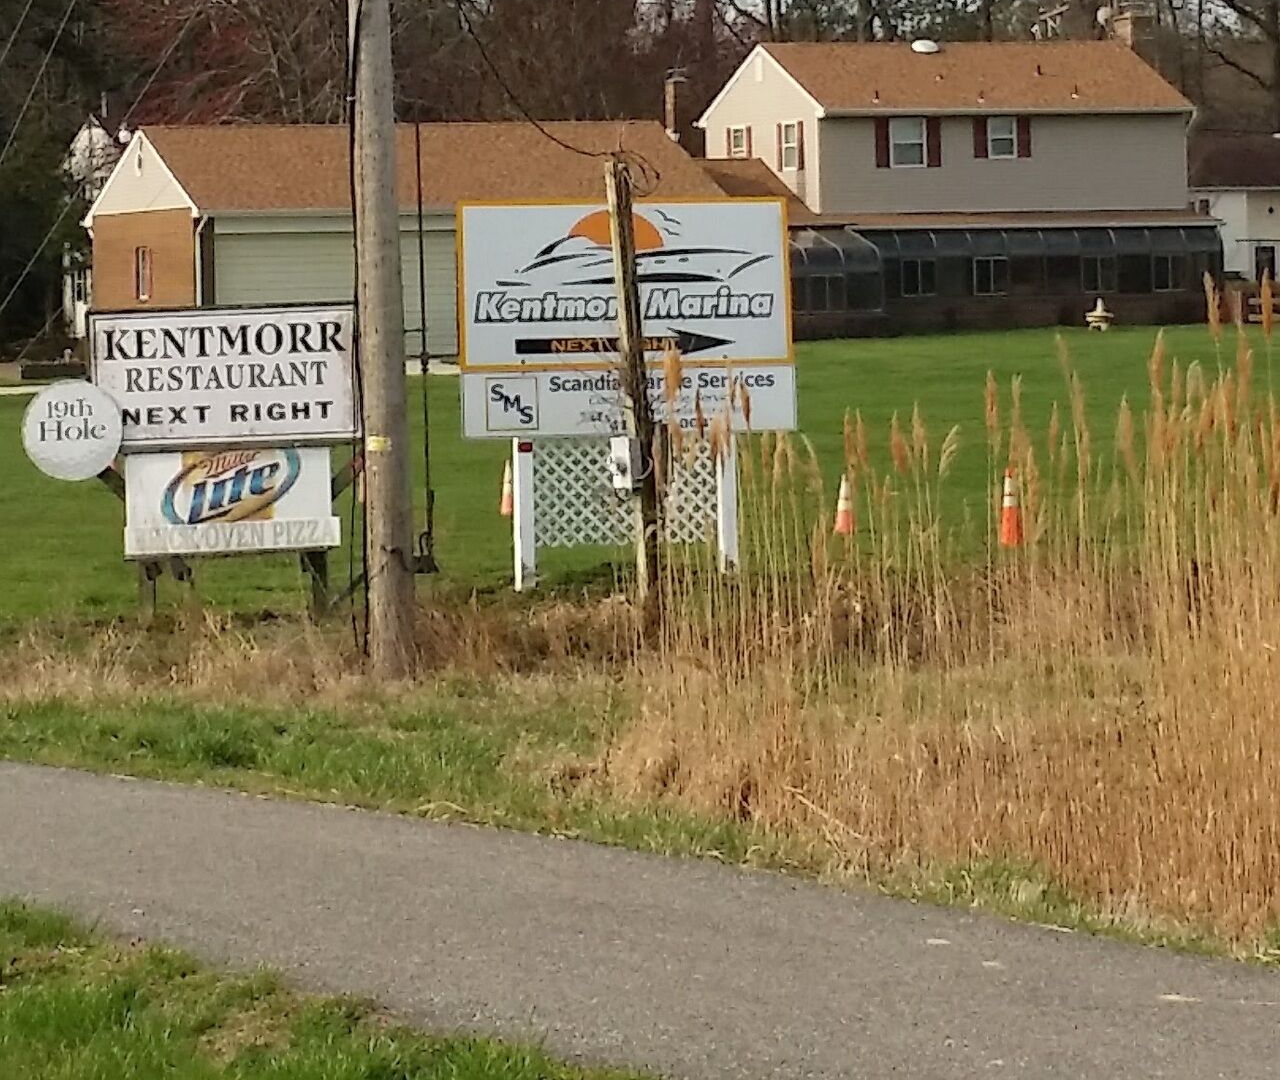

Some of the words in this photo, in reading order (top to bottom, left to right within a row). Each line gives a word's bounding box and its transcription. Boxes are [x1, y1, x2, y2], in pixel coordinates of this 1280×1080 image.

[474, 291, 619, 324] Kentmor
[645, 285, 775, 321] Marina
[102, 320, 347, 361] KENTMORR
[550, 337, 607, 353] NEXT
[125, 360, 328, 393] RESTAURANT
[46, 398, 94, 420] 19th
[122, 404, 212, 426] NEXT
[229, 400, 334, 423] RIGHT
[489, 382, 536, 426] SMS
[38, 419, 109, 442] Hole
[205, 523, 265, 550] OVEN
[273, 519, 338, 547] PIZZA
